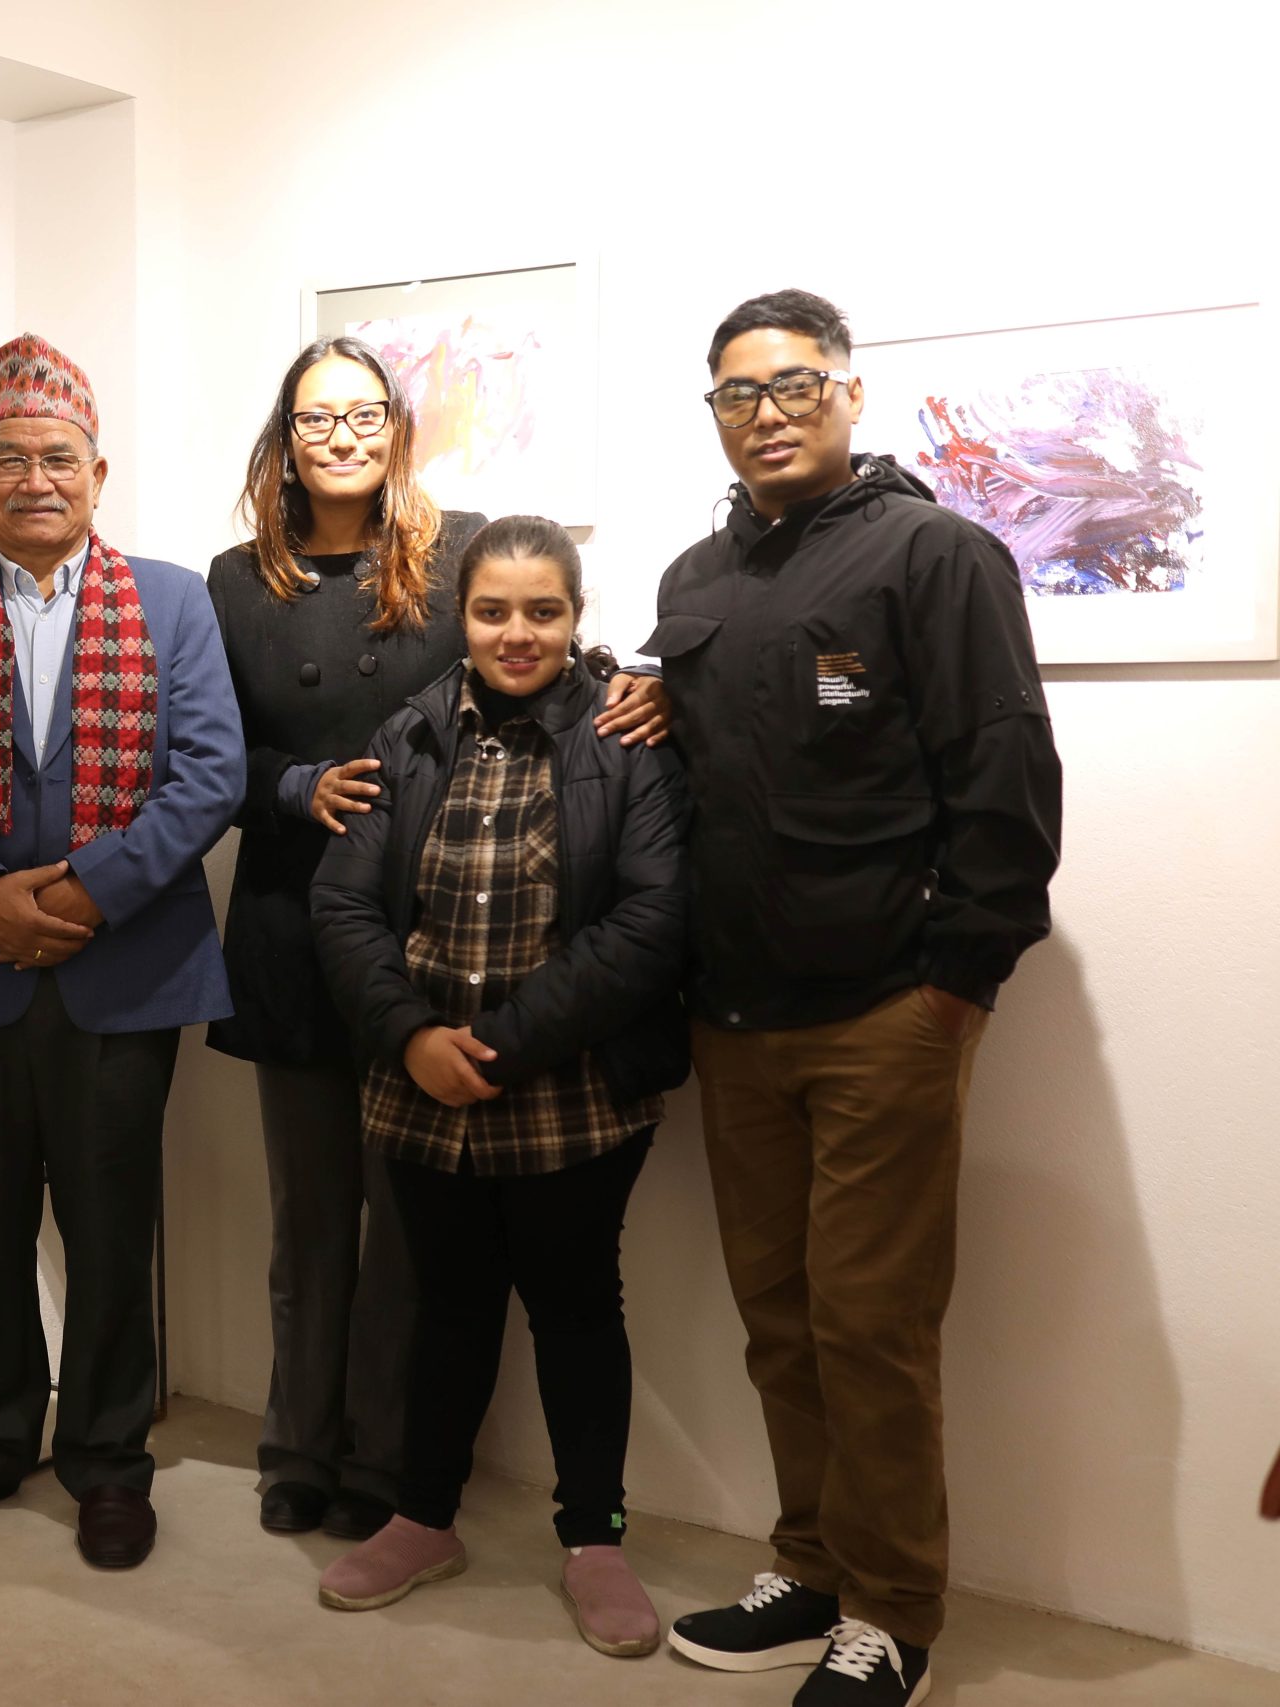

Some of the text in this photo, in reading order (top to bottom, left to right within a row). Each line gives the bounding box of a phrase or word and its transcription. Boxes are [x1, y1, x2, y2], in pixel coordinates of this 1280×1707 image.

[817, 675, 848, 684] visually
[817, 682, 856, 691] powerful.
[818, 689, 870, 698] intellectually
[818, 698, 852, 706] elegant.
